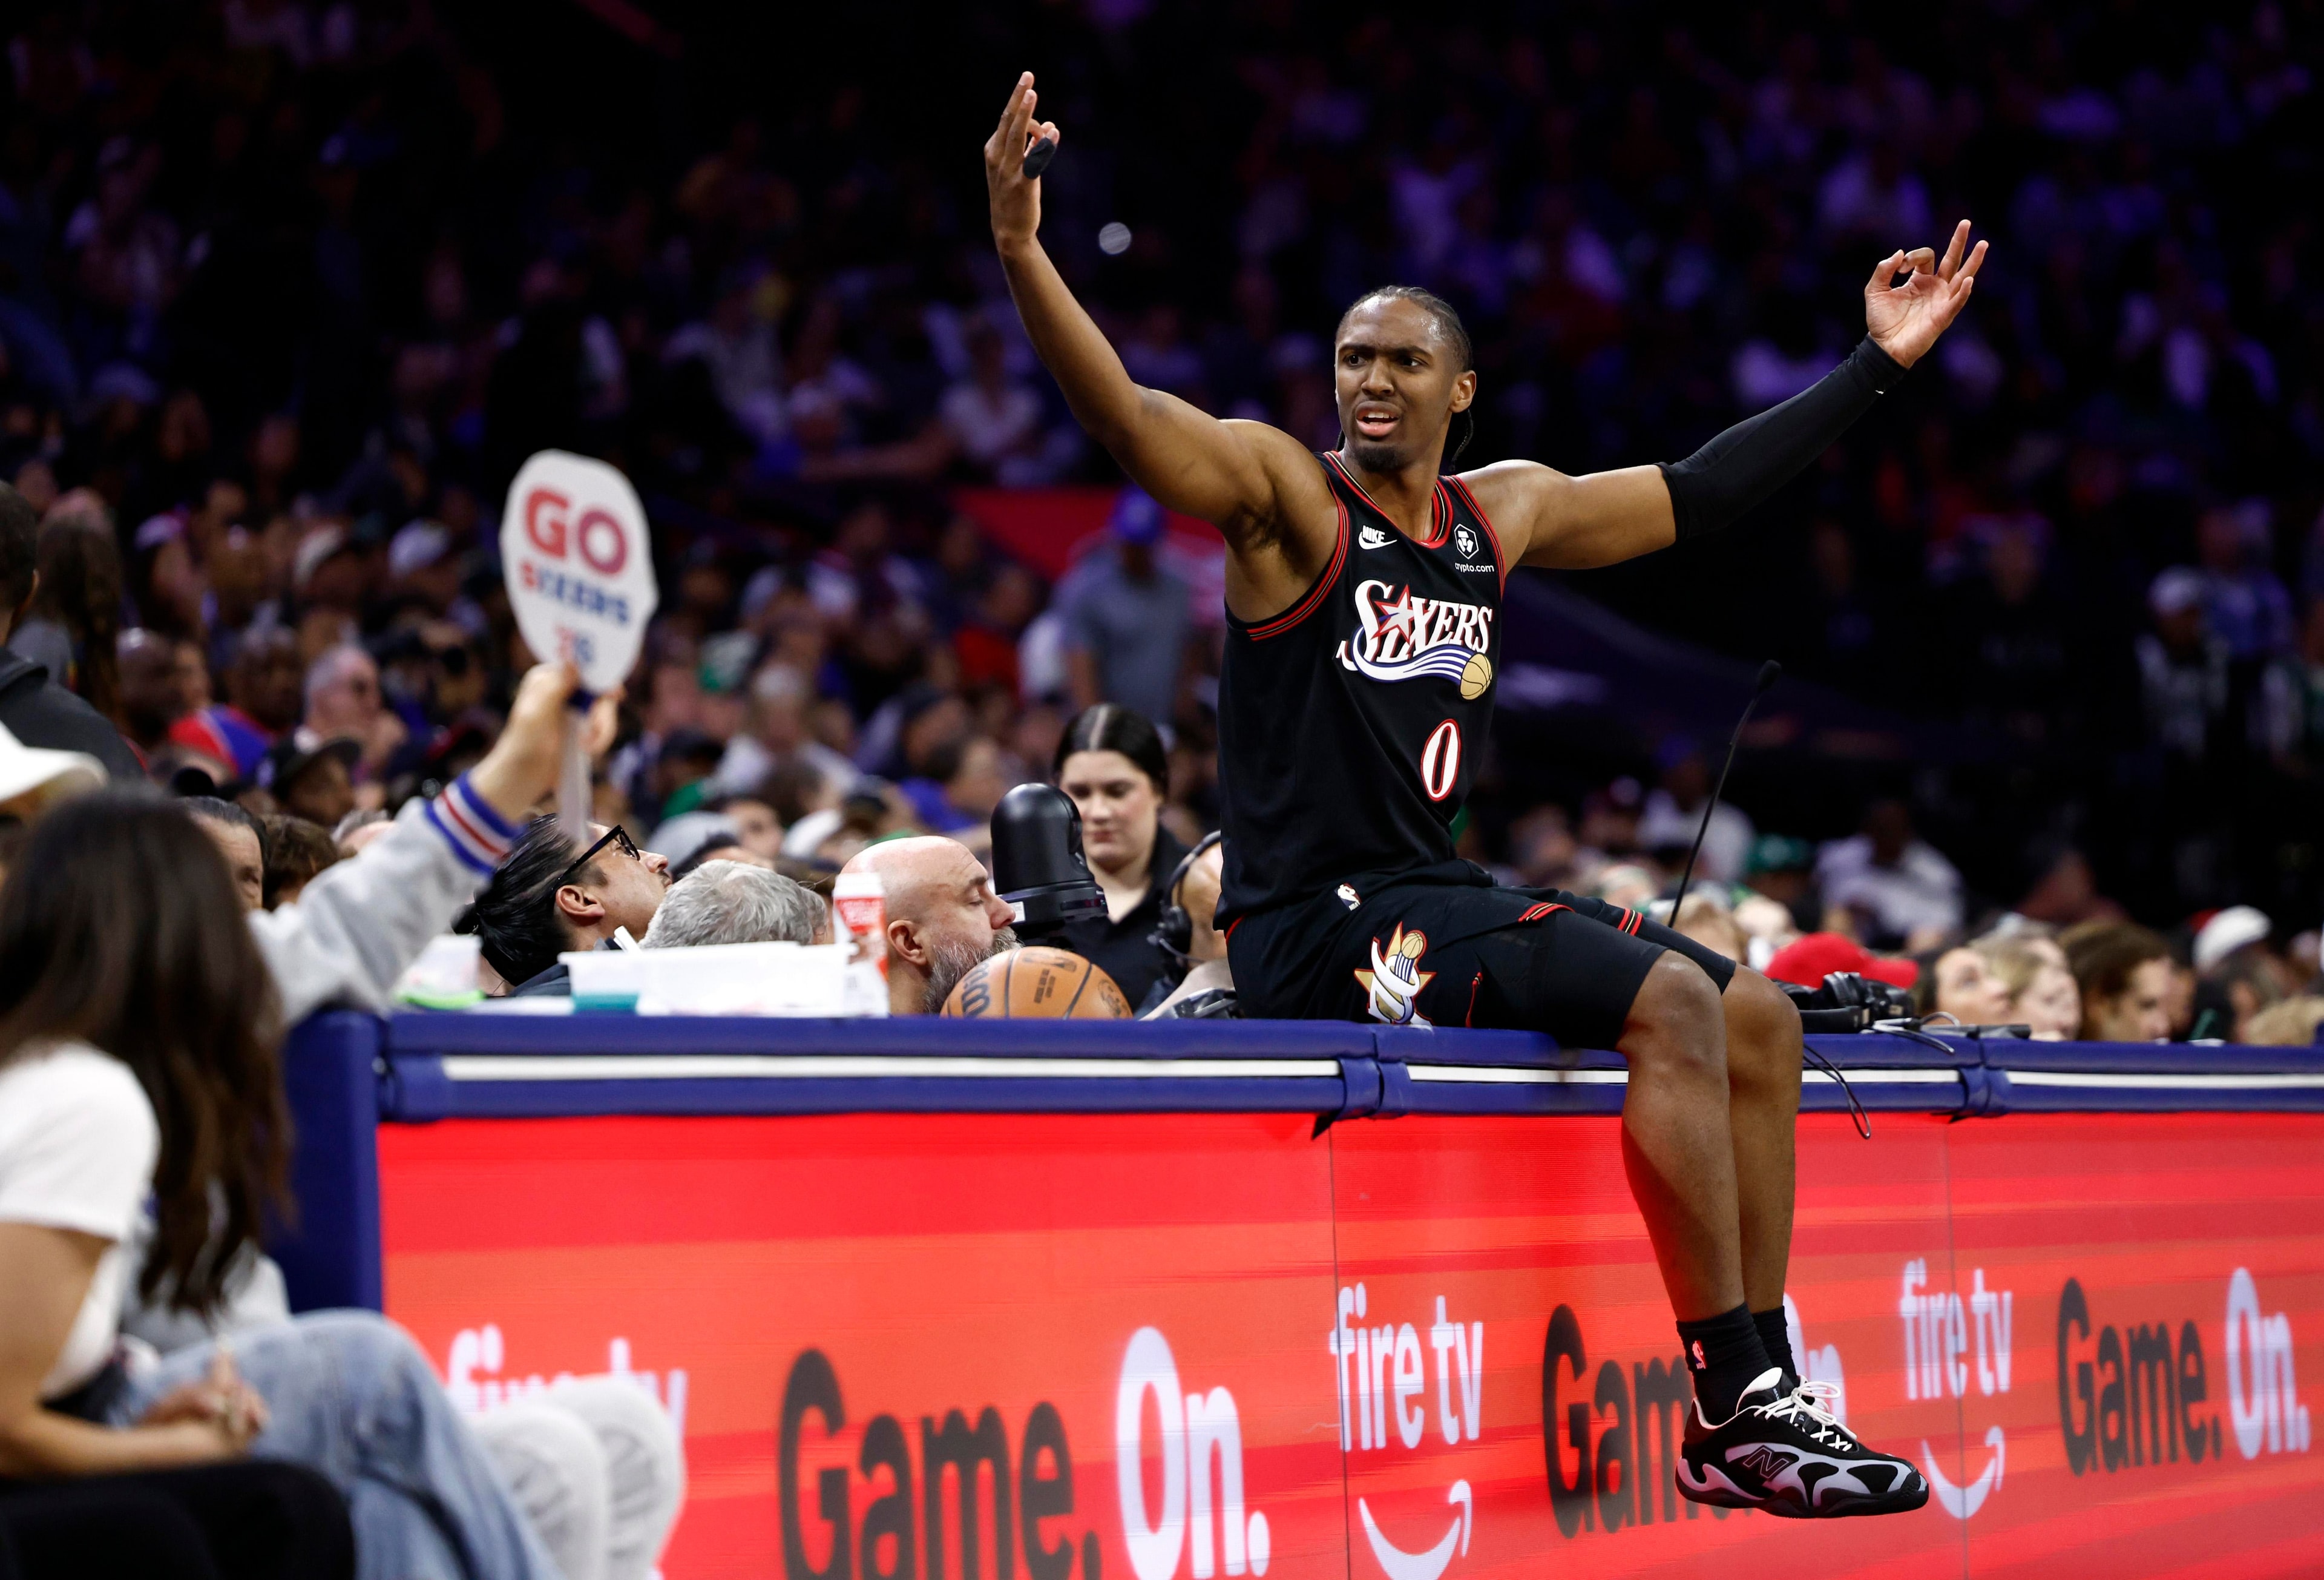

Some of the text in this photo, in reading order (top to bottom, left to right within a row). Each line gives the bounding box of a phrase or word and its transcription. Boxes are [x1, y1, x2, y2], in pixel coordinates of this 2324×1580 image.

[524, 488, 628, 575] GO
[1362, 525, 1385, 544] NIKE
[1454, 562, 1495, 573] crypto.com
[1420, 719, 1462, 802] 0
[1330, 1283, 1483, 1452] fire tv
[1900, 1257, 1968, 1400] fire
[1971, 1268, 2012, 1397] tv
[2058, 1277, 2223, 1477] Game.
[2226, 1267, 2311, 1460] On.
[1117, 1326, 1270, 1580] On.
